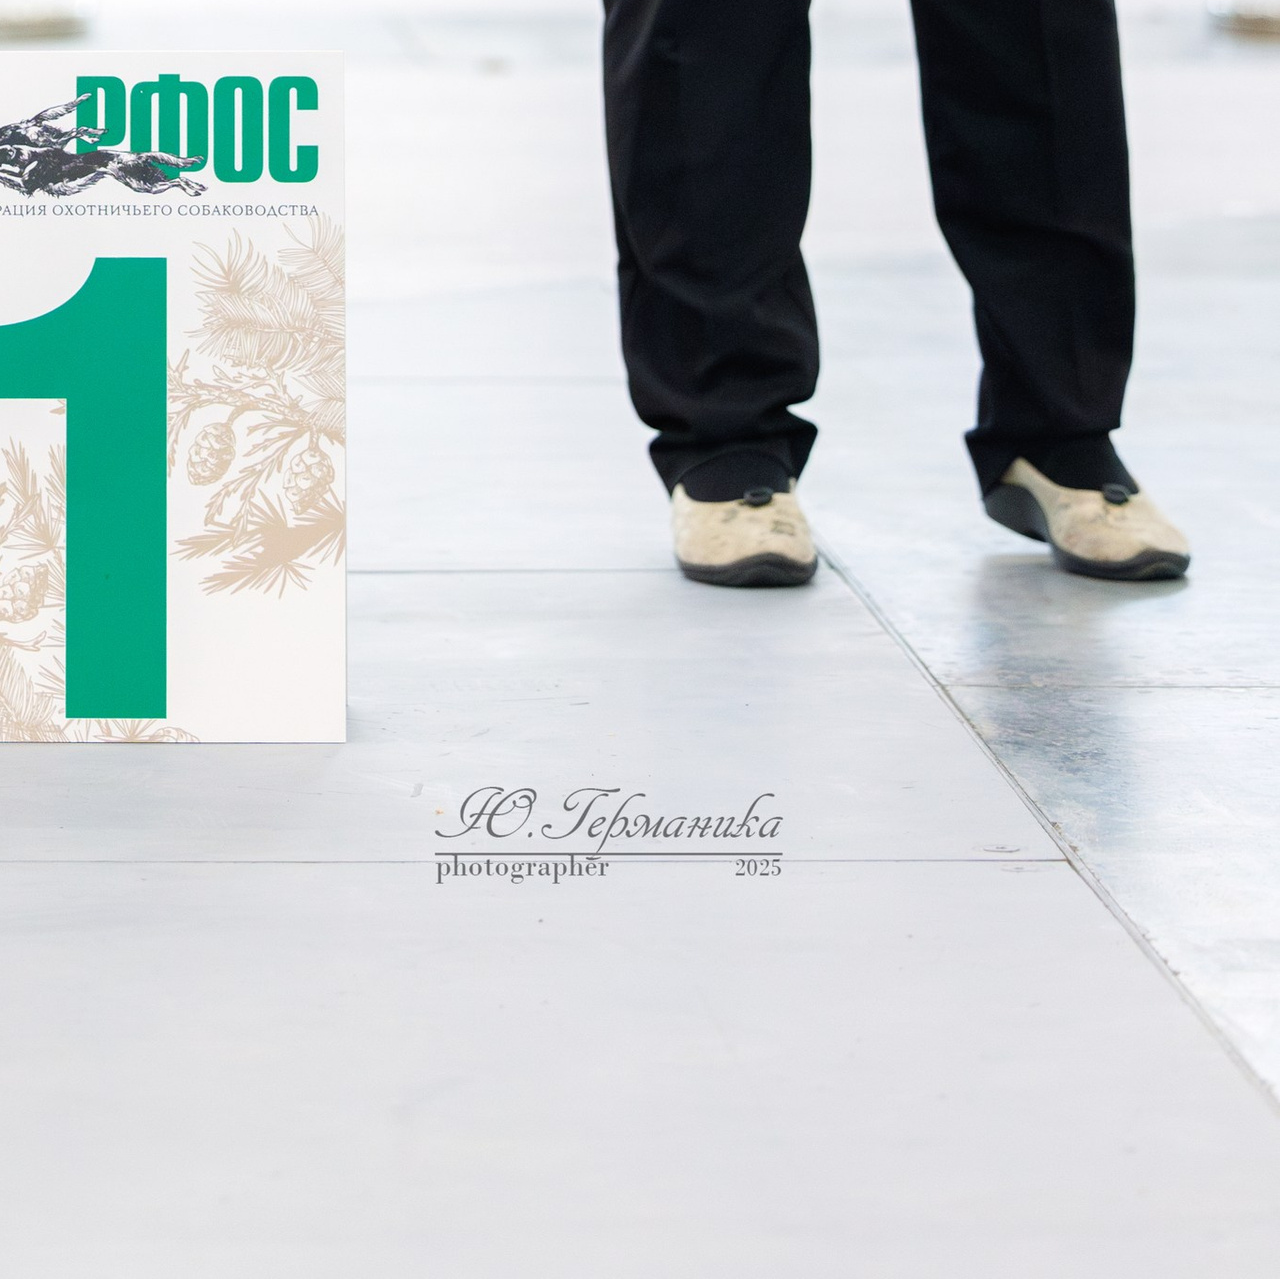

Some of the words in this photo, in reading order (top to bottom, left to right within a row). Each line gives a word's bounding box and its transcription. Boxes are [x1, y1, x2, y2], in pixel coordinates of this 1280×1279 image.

[76, 74, 319, 183] РФОС
[52, 204, 173, 217] ОХОТНИЧЬЕГО
[177, 204, 319, 217] СОБАКОВОДСТВА
